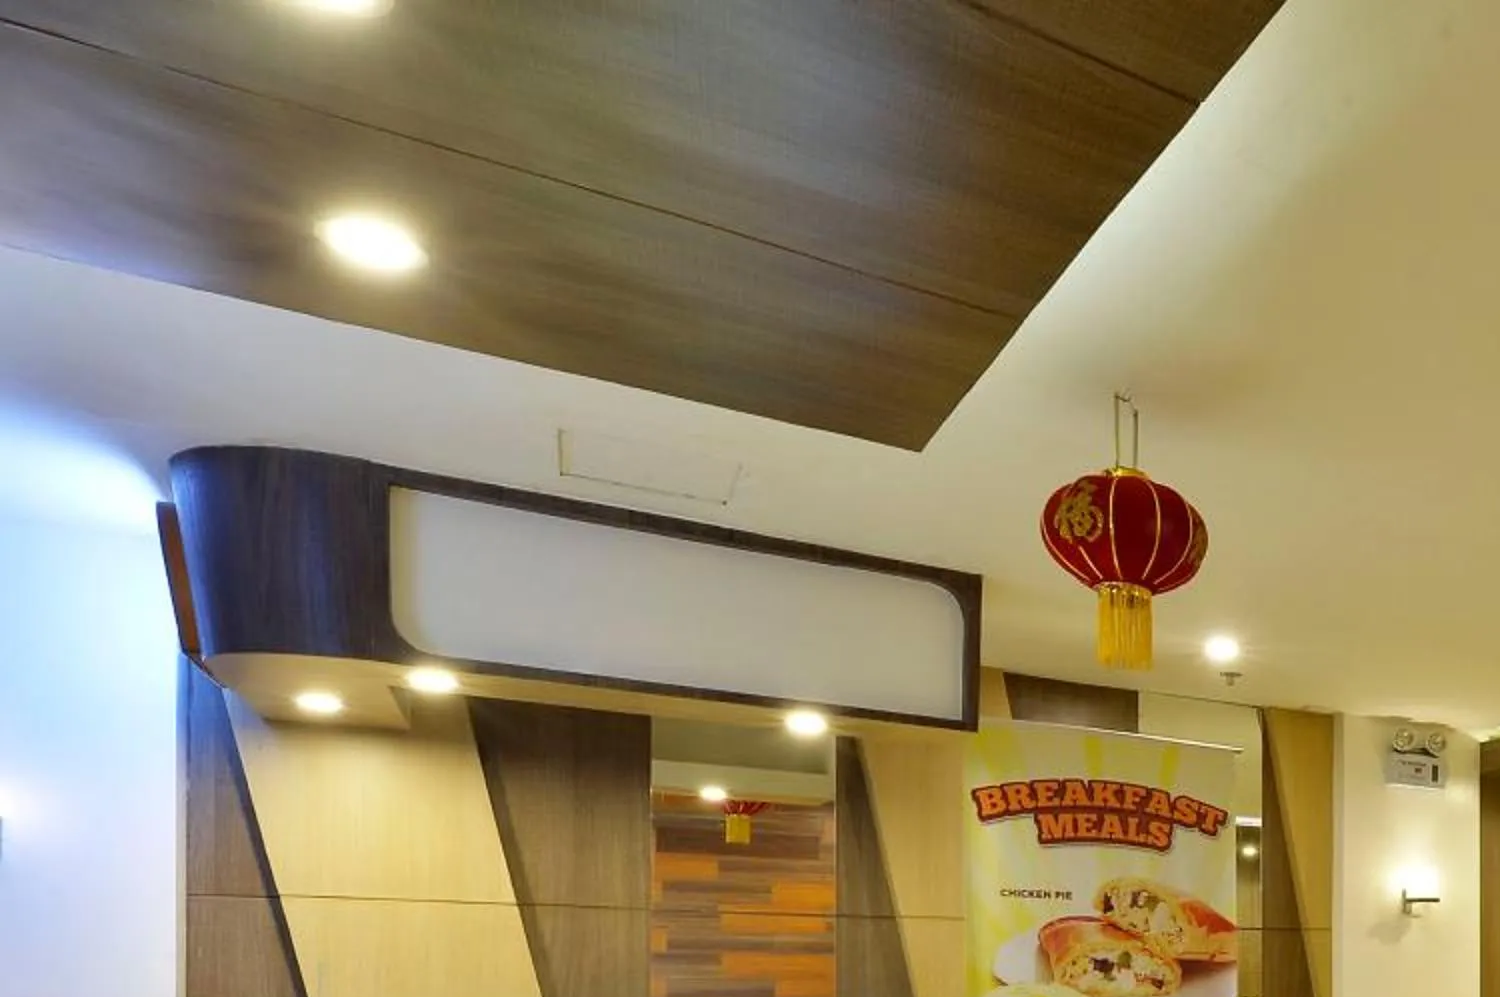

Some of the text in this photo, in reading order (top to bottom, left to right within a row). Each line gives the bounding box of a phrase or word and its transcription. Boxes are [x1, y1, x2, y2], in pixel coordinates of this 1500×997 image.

[971, 779, 1229, 836] BREAKFAST
[1035, 811, 1175, 851] MEALS
[999, 888, 1073, 901] CHICKEN PIE
